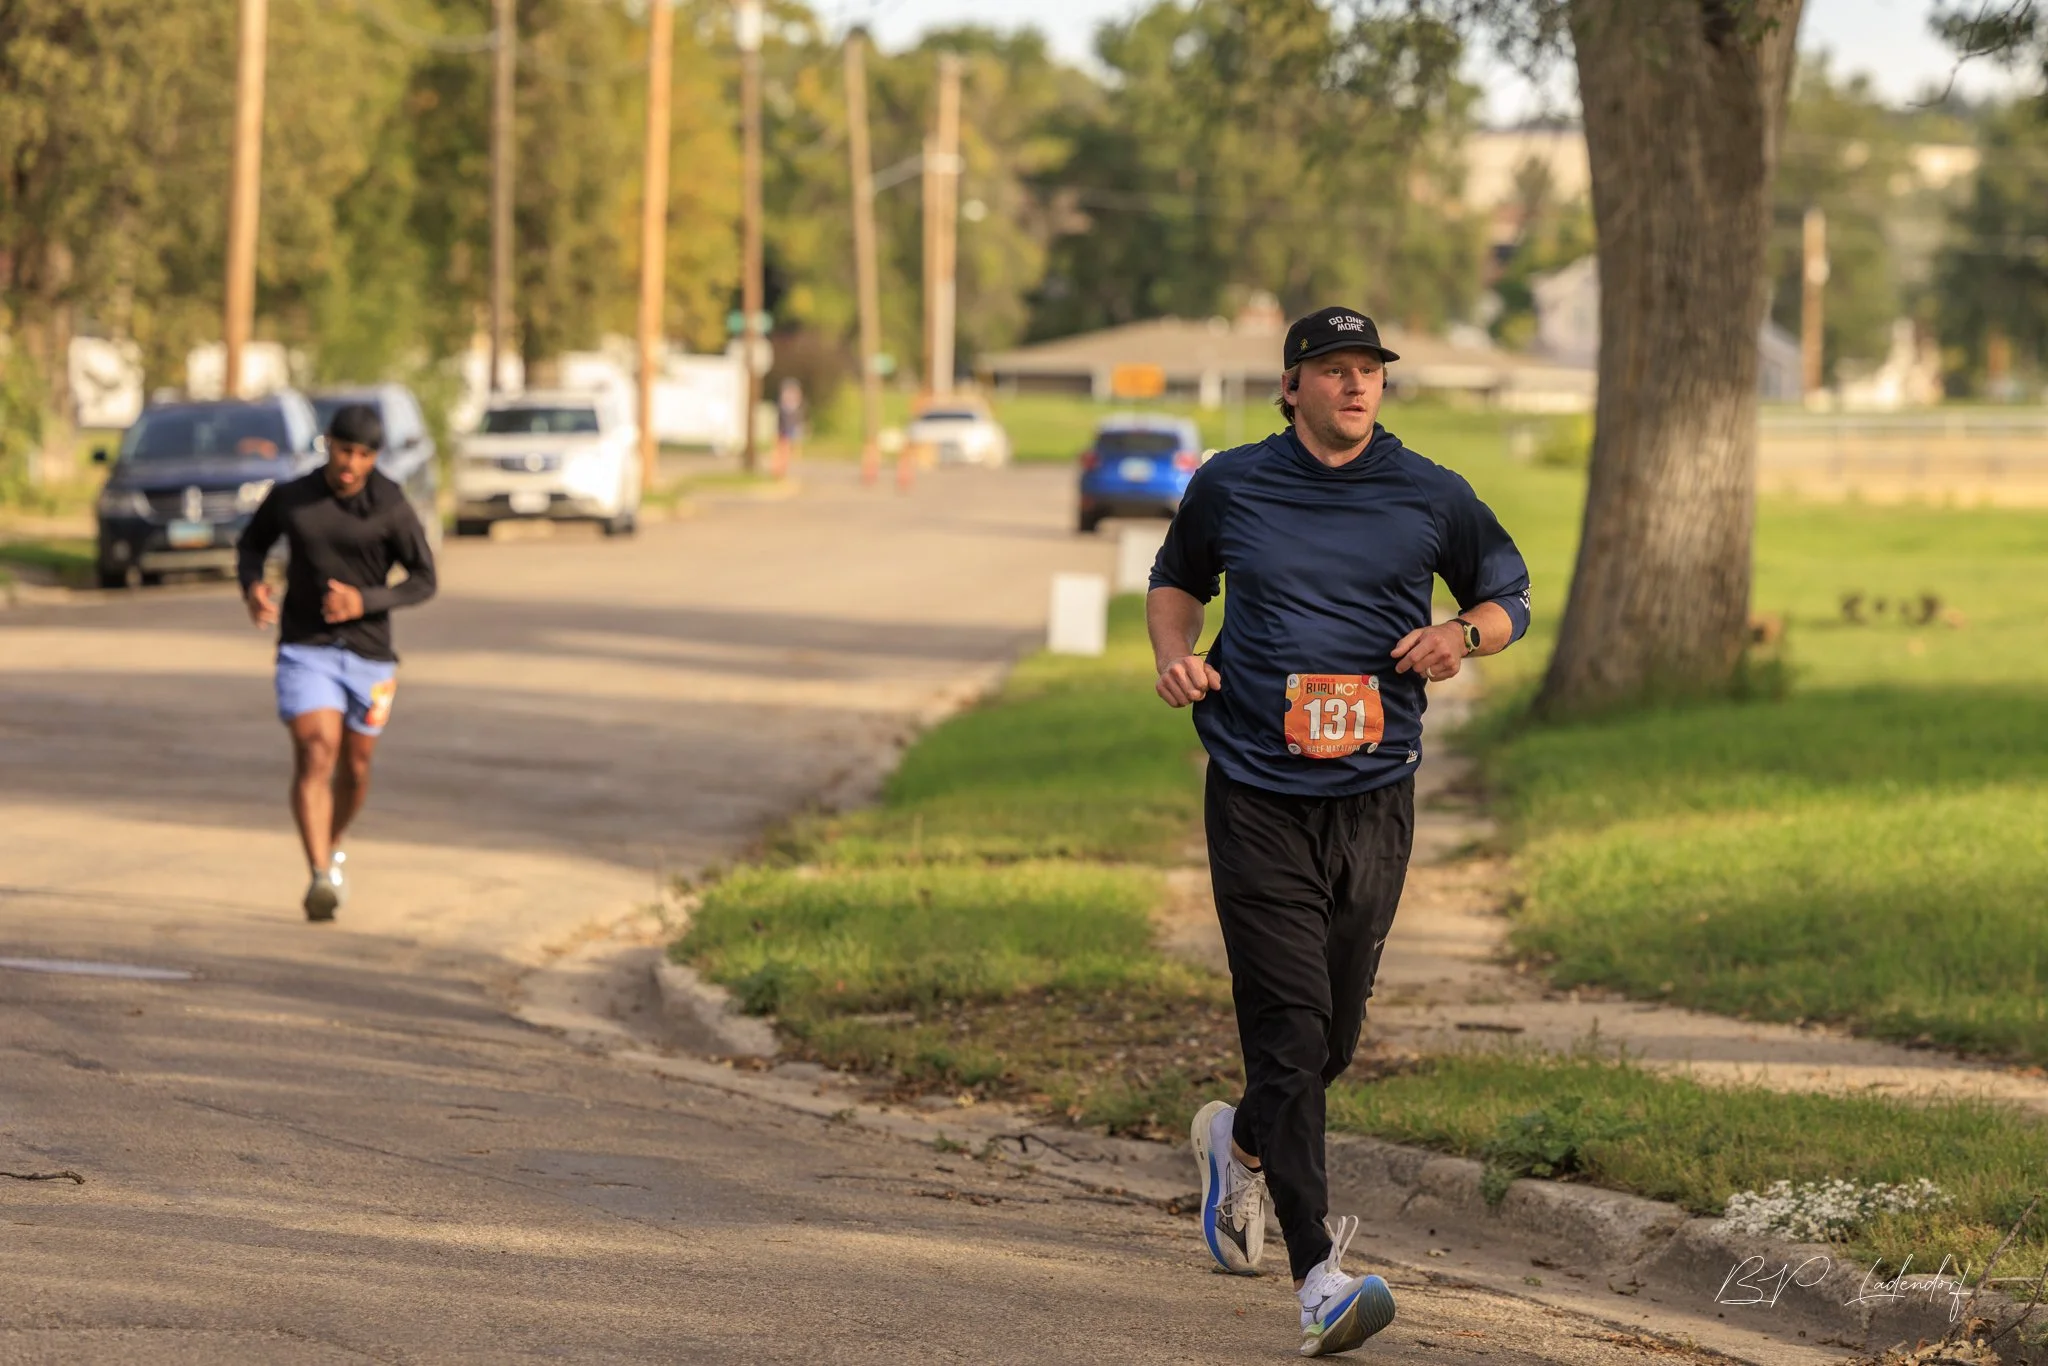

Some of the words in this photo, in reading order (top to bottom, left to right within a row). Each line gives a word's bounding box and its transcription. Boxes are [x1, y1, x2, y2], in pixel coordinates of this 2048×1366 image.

[1329, 316, 1344, 326] GO
[1345, 315, 1365, 327] ONE
[1337, 323, 1364, 332] MORE
[1303, 698, 1365, 740] 131
[1306, 745, 1325, 753] HALF
[1326, 744, 1361, 753] MARATHON
